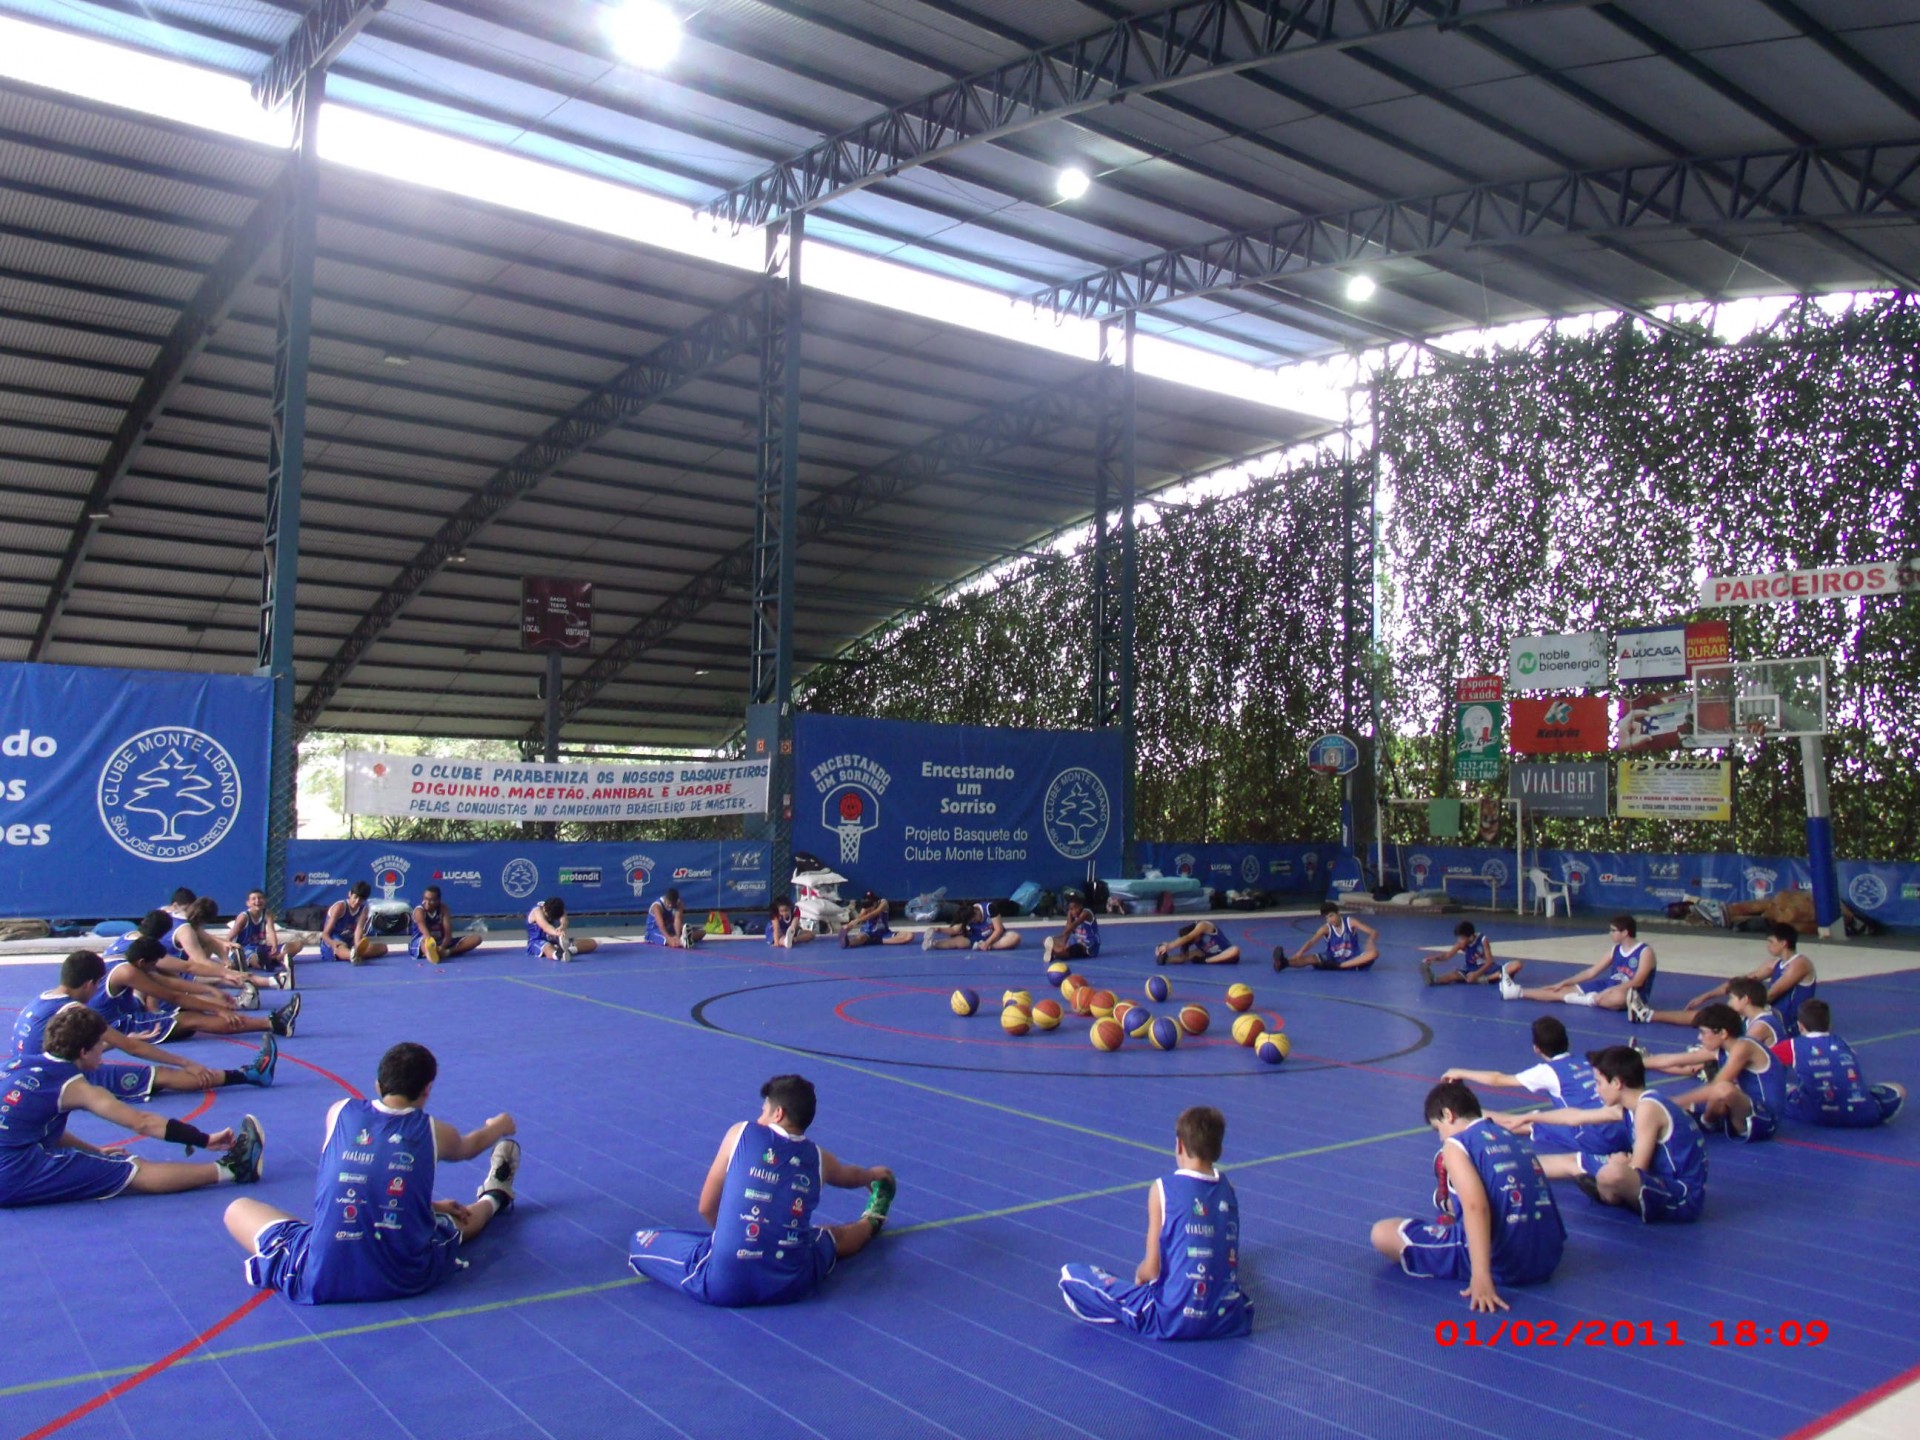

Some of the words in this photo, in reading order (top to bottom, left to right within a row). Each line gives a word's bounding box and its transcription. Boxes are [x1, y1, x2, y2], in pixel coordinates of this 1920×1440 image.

[1715, 567, 1886, 602] PARCEIROS
[1539, 649, 1570, 660] noble
[1632, 646, 1681, 658] LUCASA
[1687, 644, 1727, 659] DURAR
[1539, 658, 1600, 672] bioenergia
[1460, 678, 1498, 691] Esporte
[1468, 690, 1497, 700] saúde
[2, 729, 57, 757] do
[105, 748, 137, 806] CLUBE
[137, 732, 204, 754] MONTE
[412, 764, 423, 776] O
[430, 765, 482, 780] CLUBE
[493, 768, 588, 784] PARABENIZA
[597, 771, 614, 784] OS
[622, 770, 674, 784] NOSSOS
[680, 765, 768, 783] BASQUETEIROS
[810, 754, 892, 787] ENCESTANDO
[921, 761, 1015, 780] Encestando
[0, 779, 26, 801] s
[592, 787, 654, 799] ANNIBAL
[661, 787, 670, 797] E
[676, 780, 732, 796] JACARÉ
[816, 776, 836, 793] UM
[839, 769, 886, 796] SORRISO
[956, 783, 982, 795] um
[1047, 782, 1061, 822] CLUBE
[1060, 772, 1092, 786] MONTE
[409, 799, 450, 813] PELAS
[456, 802, 528, 815] CONQUISTAS
[534, 804, 547, 816] NO
[552, 804, 621, 816] CAMPEONATO
[627, 802, 686, 815] BRASILEIRO
[690, 801, 701, 811] DE
[940, 798, 997, 814] Sorriso
[0, 823, 51, 845] es
[111, 815, 129, 838] SÃO
[125, 834, 155, 855] JOSÉ
[157, 846, 175, 856] DO
[178, 843, 199, 856] RIO
[198, 816, 228, 846] PRETO
[905, 826, 950, 844] Projeto
[954, 827, 1009, 844] Basquete
[1013, 827, 1028, 842] do
[904, 846, 942, 861] Clube
[945, 847, 984, 861] Monte
[987, 846, 1027, 861] Líbano
[308, 878, 348, 887] bioenergia
[442, 871, 481, 880] LUCASA
[560, 872, 600, 882] protendit
